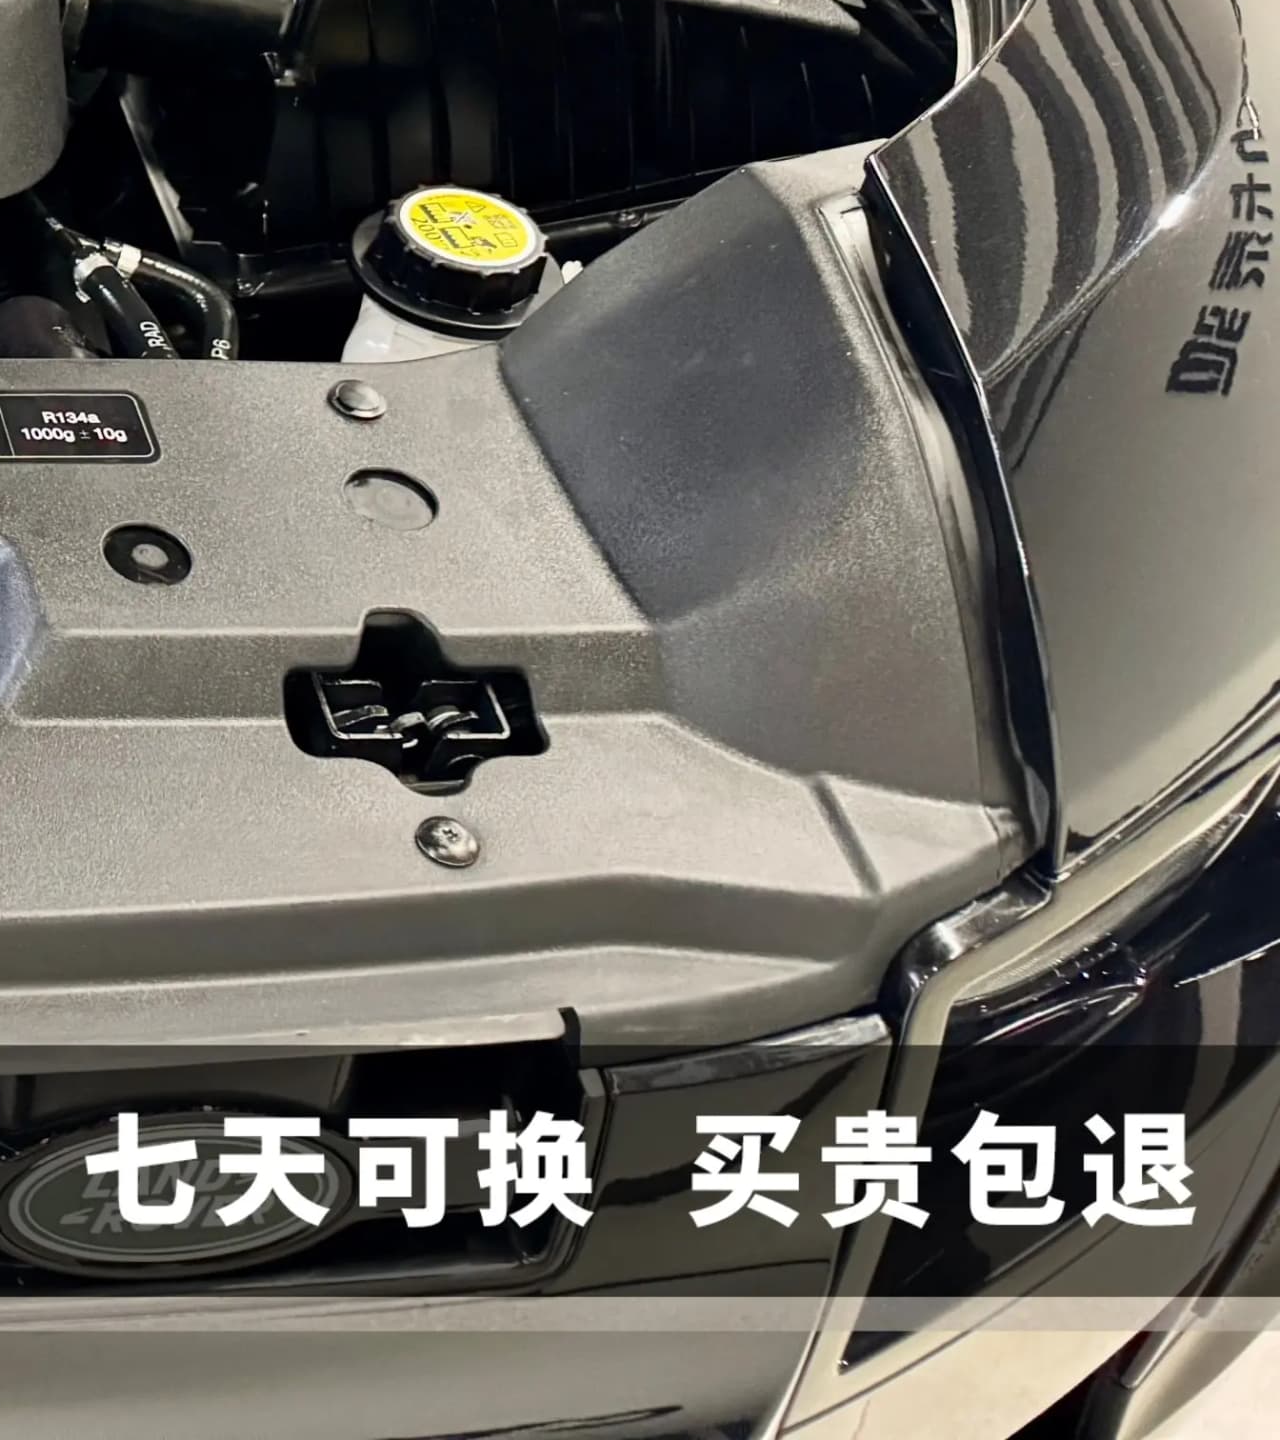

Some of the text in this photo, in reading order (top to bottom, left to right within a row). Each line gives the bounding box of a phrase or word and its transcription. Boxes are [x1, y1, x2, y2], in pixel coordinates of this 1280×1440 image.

[41, 410, 101, 425] R134a
[20, 427, 75, 443] 1000g
[93, 427, 128, 443] 10g
